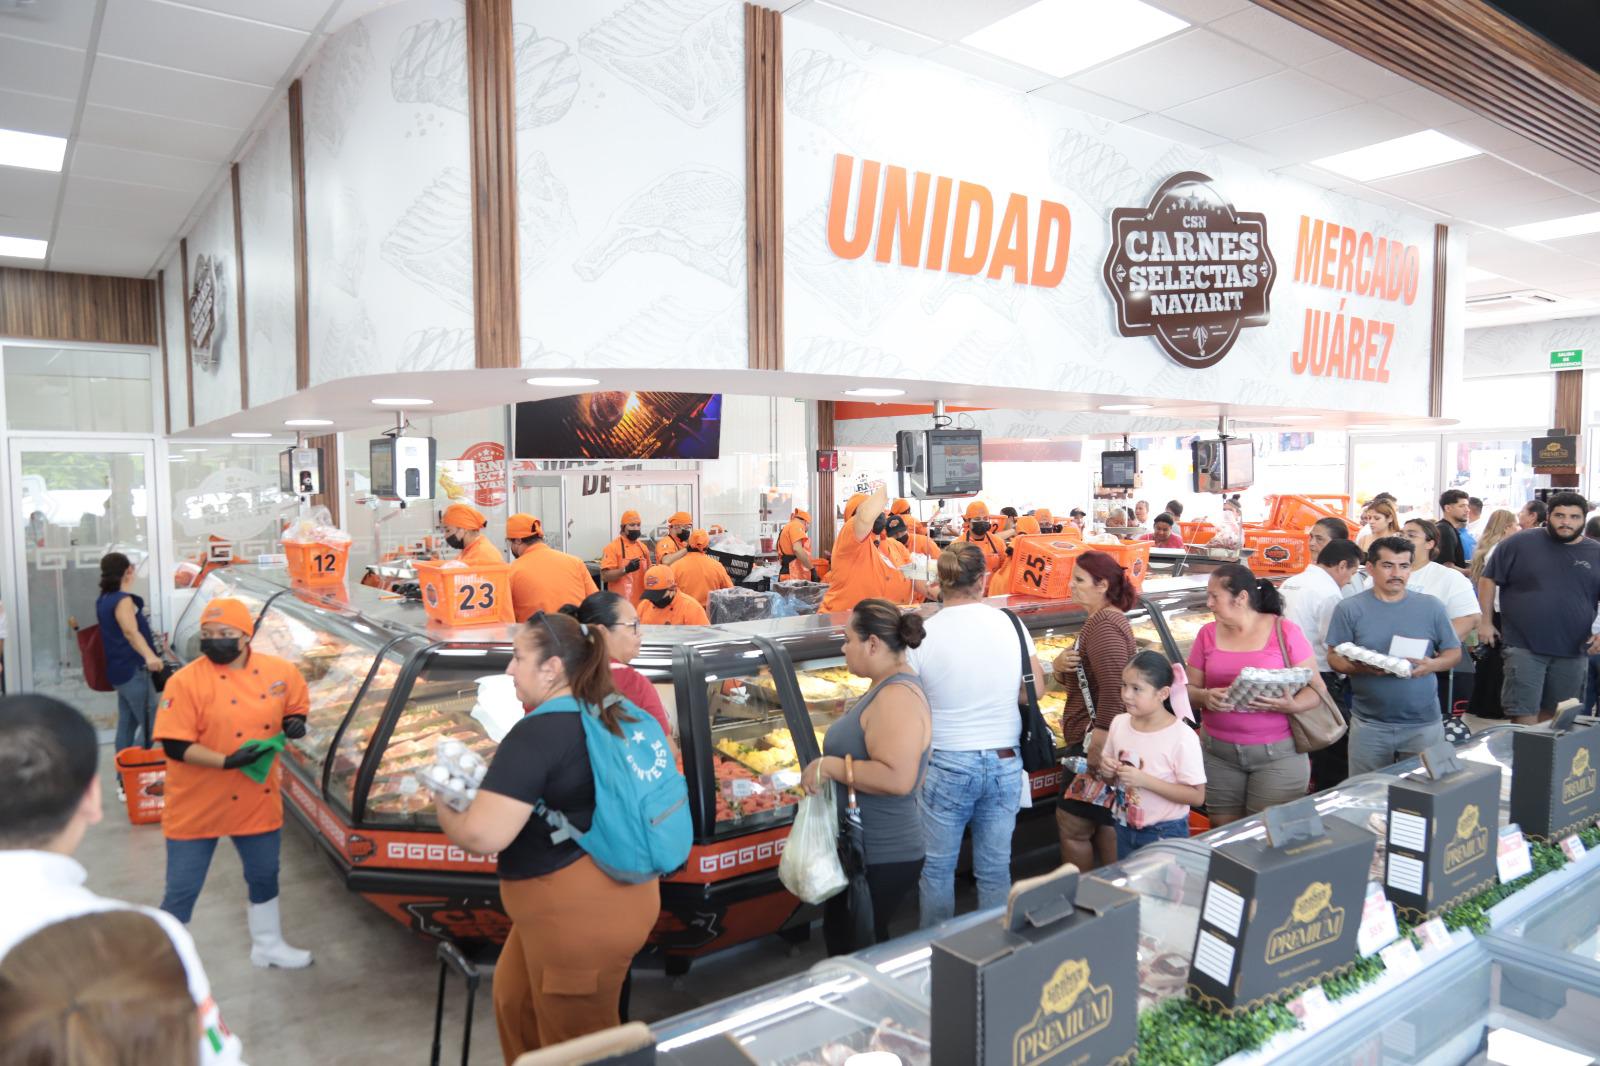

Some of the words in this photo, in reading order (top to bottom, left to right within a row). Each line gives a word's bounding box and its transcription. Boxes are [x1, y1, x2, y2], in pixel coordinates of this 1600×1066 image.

[827, 153, 1072, 289] UNIDAD
[1182, 215, 1207, 229] CSN
[1125, 230, 1259, 262] CARNES
[1294, 214, 1420, 306] MERCADO
[1129, 263, 1259, 292] SELECTAS
[1151, 291, 1244, 316] NAYARIT
[1292, 297, 1395, 383] JUÁREZ
[313, 553, 336, 573] 12
[1023, 554, 1046, 588] 25
[459, 582, 495, 611] 23
[1270, 915, 1341, 957] PREMIUM
[1019, 994, 1108, 1065] PREMIUM
